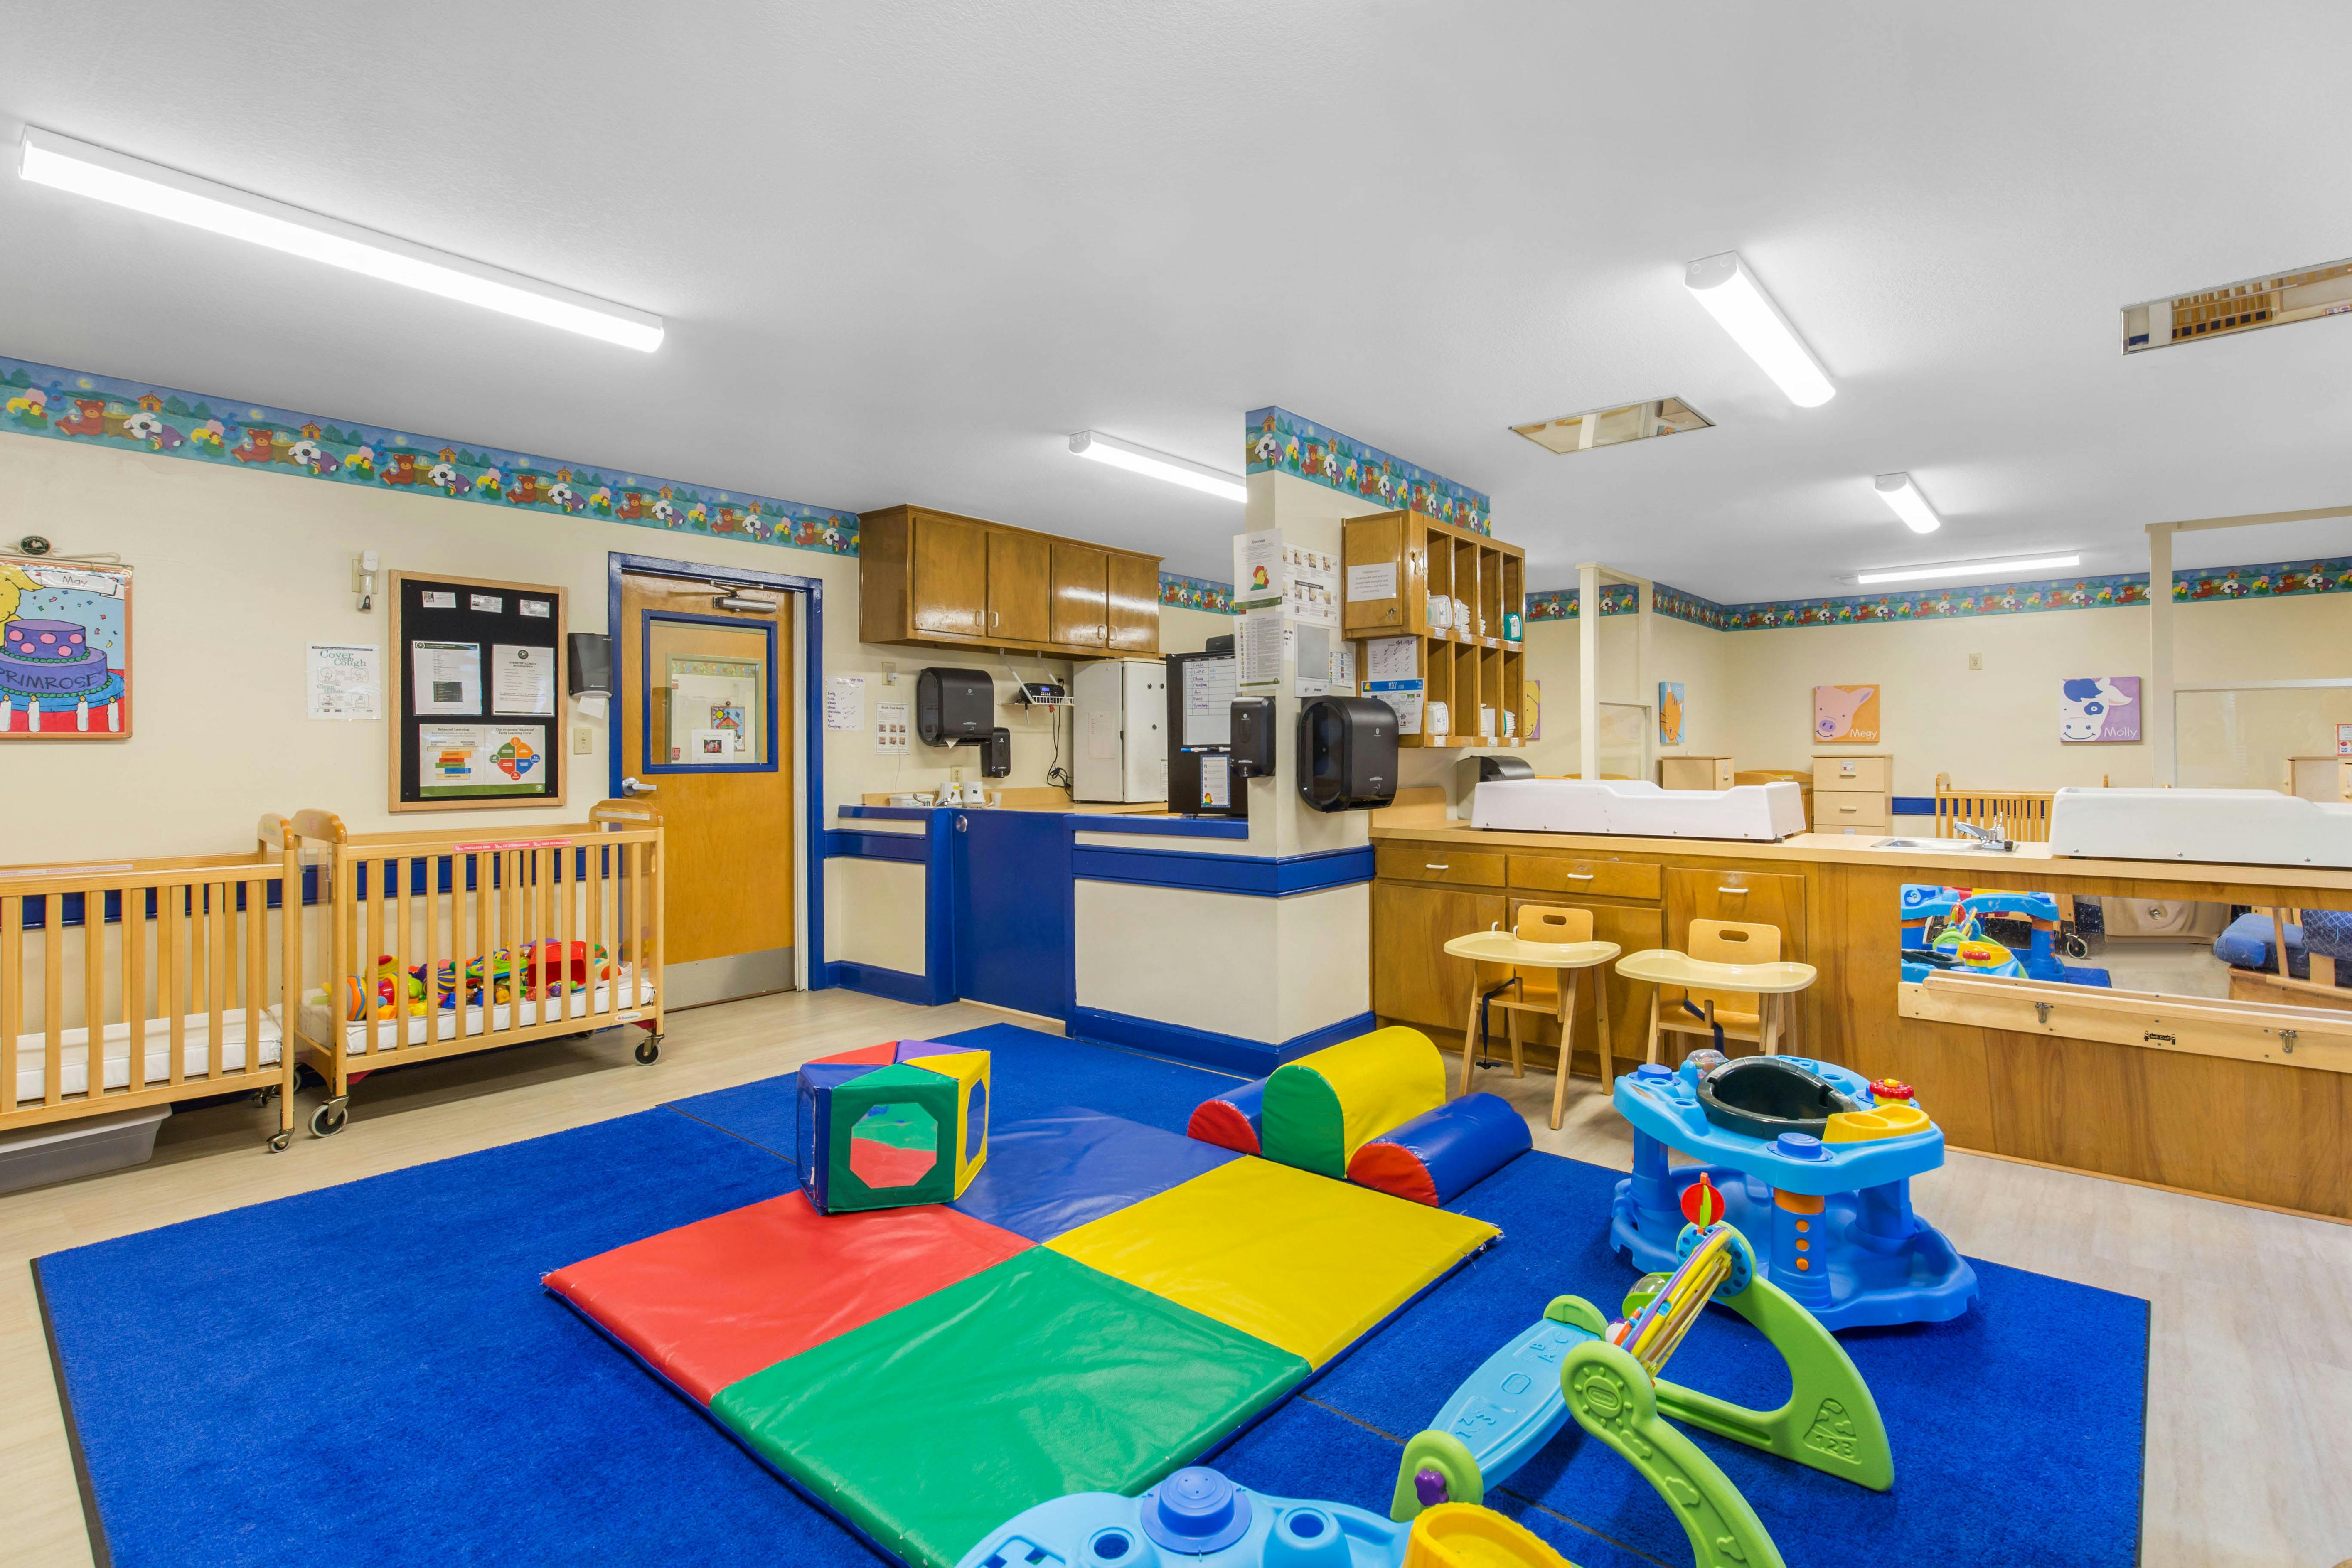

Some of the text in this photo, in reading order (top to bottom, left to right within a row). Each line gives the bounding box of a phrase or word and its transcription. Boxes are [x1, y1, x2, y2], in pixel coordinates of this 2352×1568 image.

[62, 576, 88, 587] May
[320, 650, 354, 659] Cover
[334, 658, 366, 668] Cough
[1850, 728, 1877, 740] Megy
[2104, 726, 2138, 739] Molly
